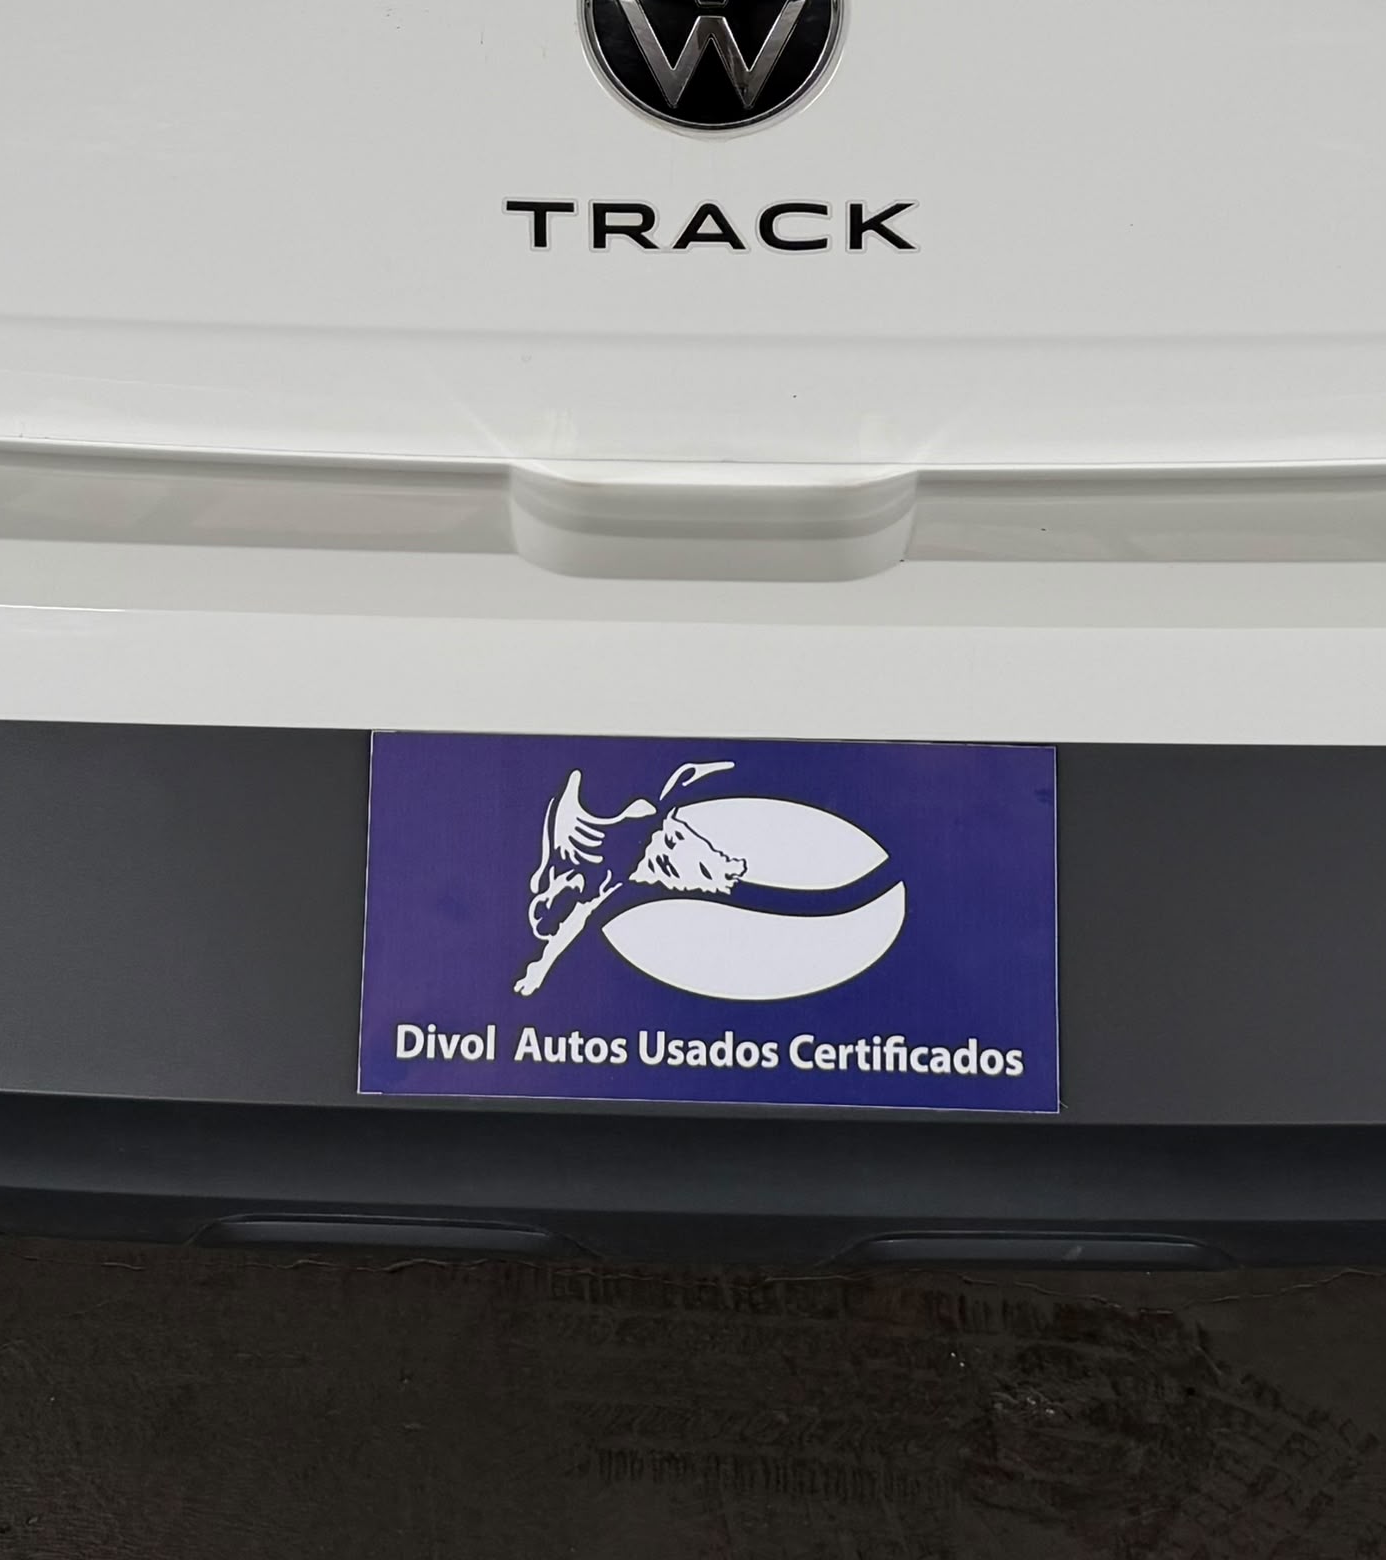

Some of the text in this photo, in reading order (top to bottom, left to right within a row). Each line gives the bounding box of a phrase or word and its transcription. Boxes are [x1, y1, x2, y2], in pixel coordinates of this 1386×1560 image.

[505, 199, 918, 251] TRACK
[395, 1023, 1024, 1076] Divol Autos Usados Certificados
